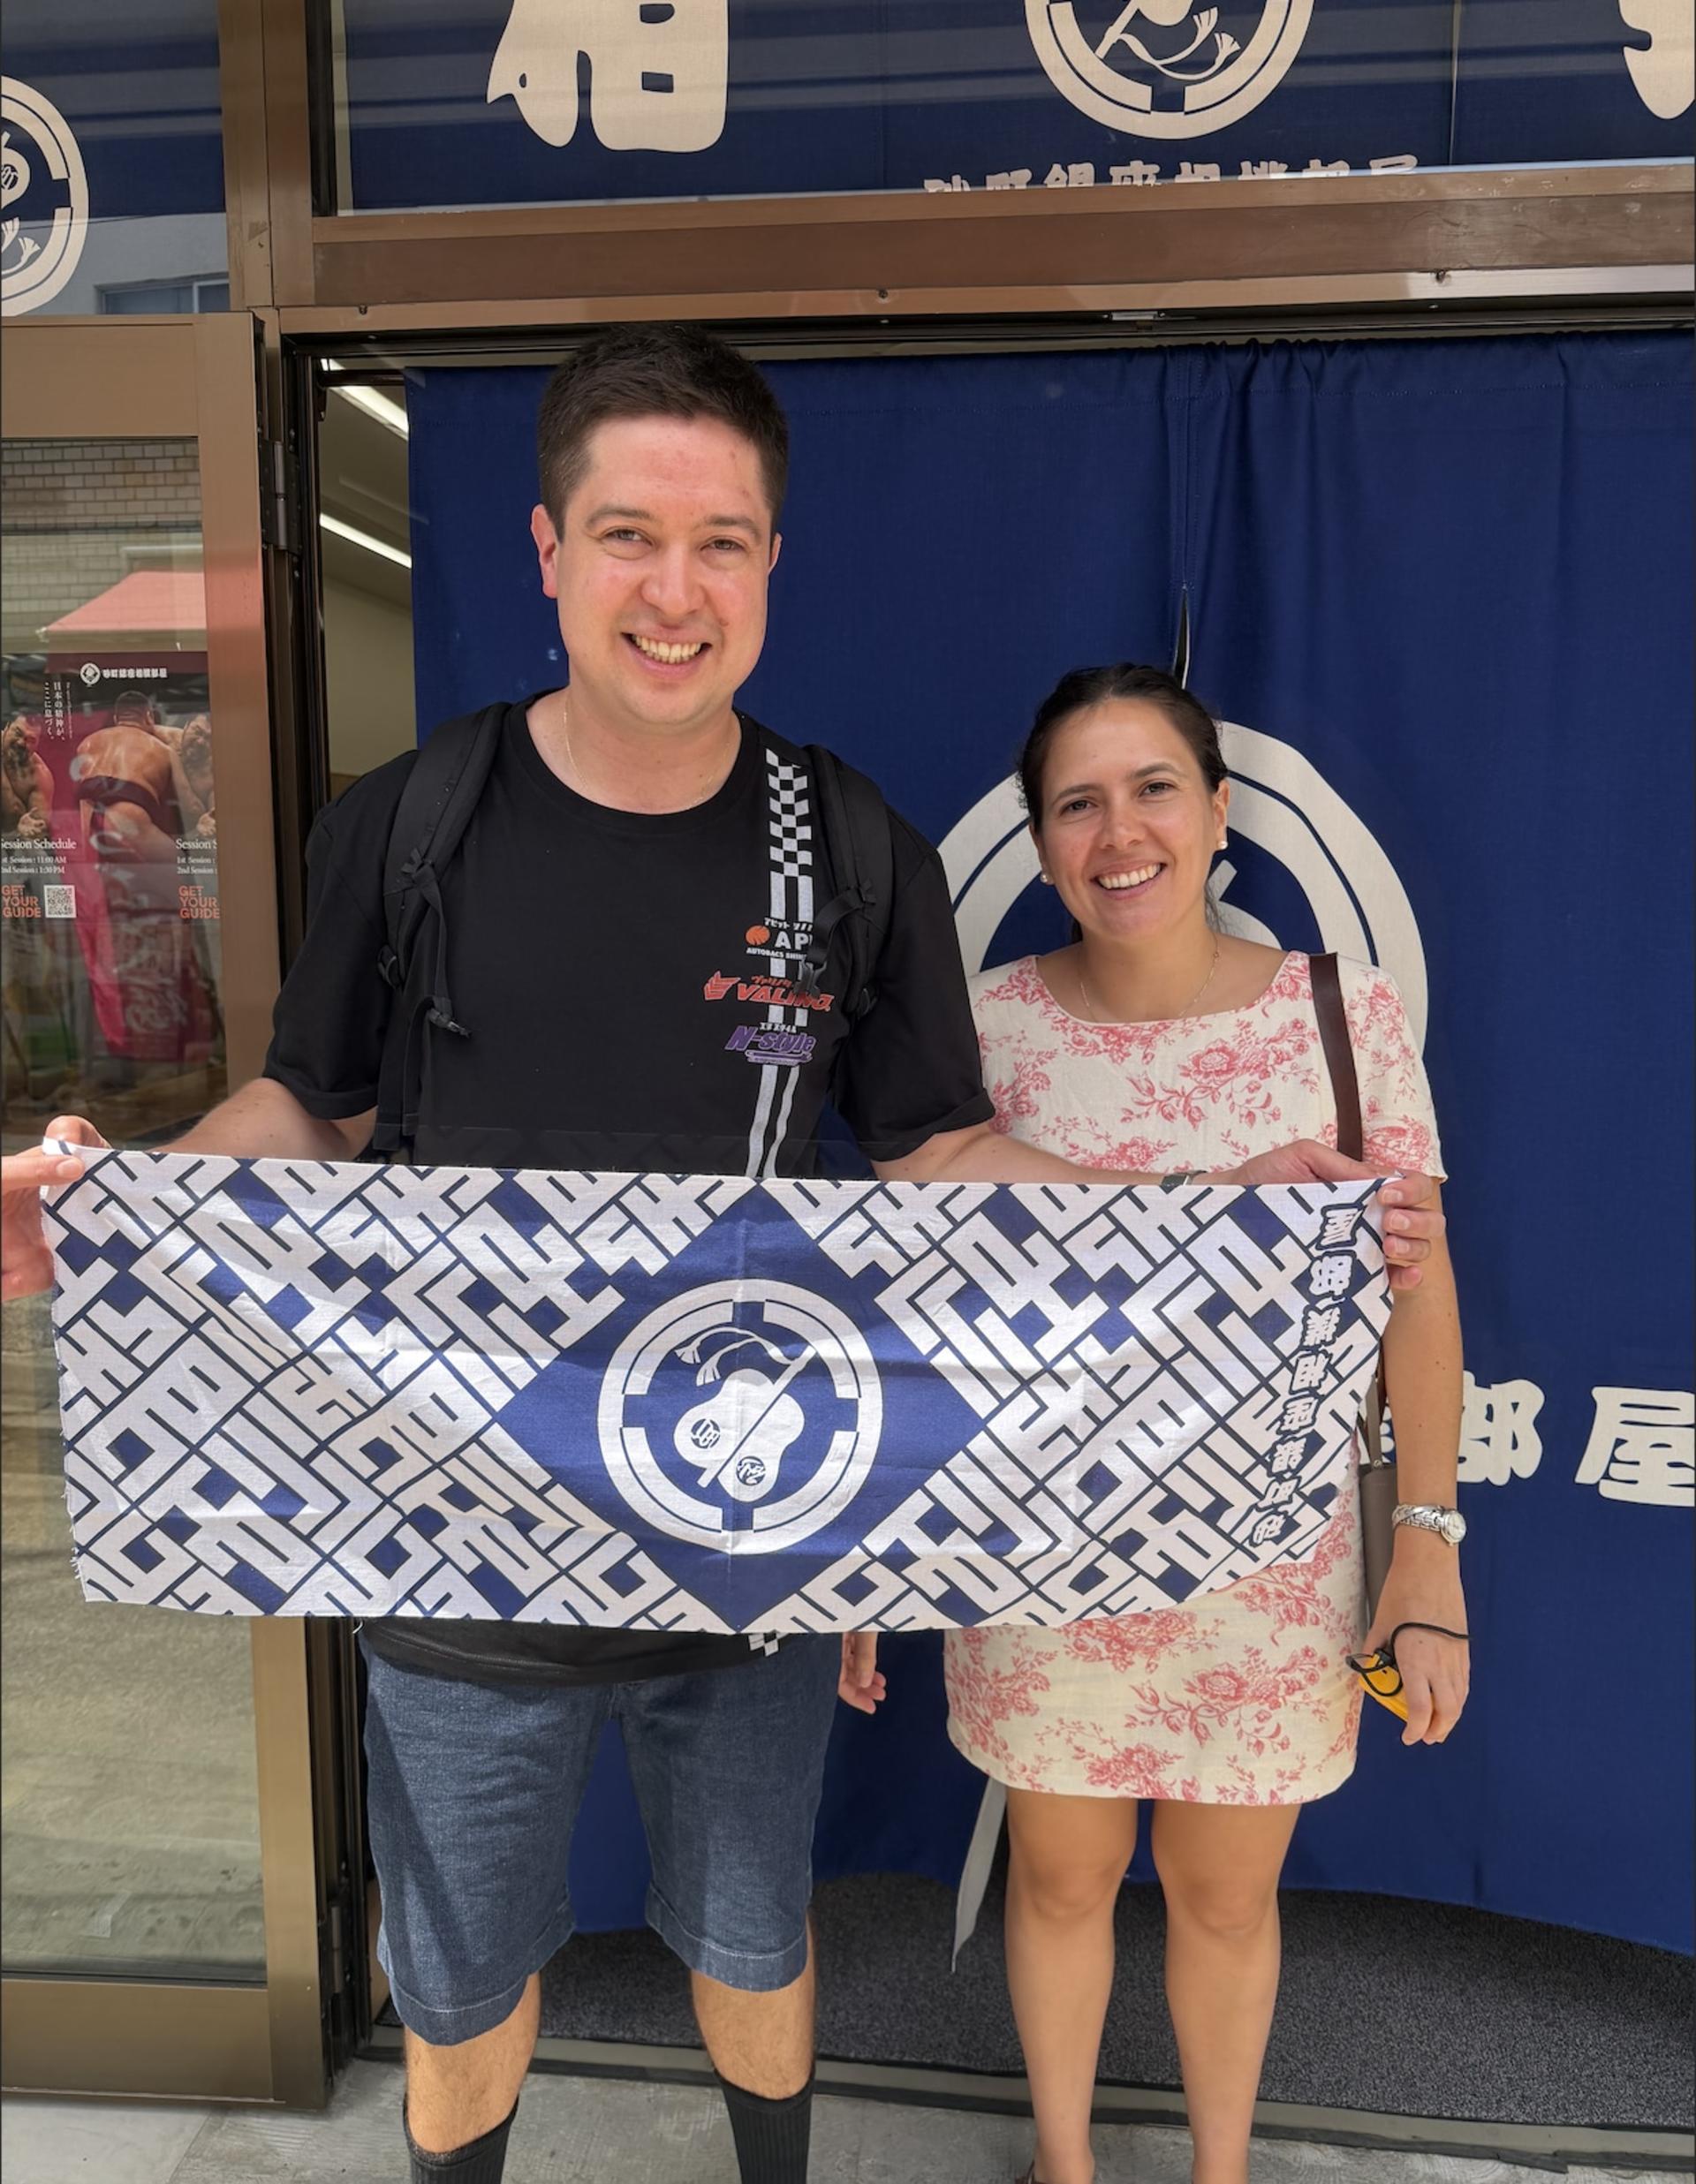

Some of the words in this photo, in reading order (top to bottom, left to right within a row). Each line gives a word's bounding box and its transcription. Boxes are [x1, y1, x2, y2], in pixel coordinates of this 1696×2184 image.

[34, 837, 77, 849] Schedule
[176, 838, 212, 849] Session
[53, 865, 65, 874] PM
[1, 885, 25, 896] GET
[178, 886, 204, 896] GET
[2, 896, 39, 907] YOUR
[179, 896, 218, 908] YOUR
[3, 907, 42, 918] GUIDE
[179, 908, 221, 918] GUIDE
[746, 947, 784, 958] AUTOBACS
[724, 1025, 816, 1054] N-style
